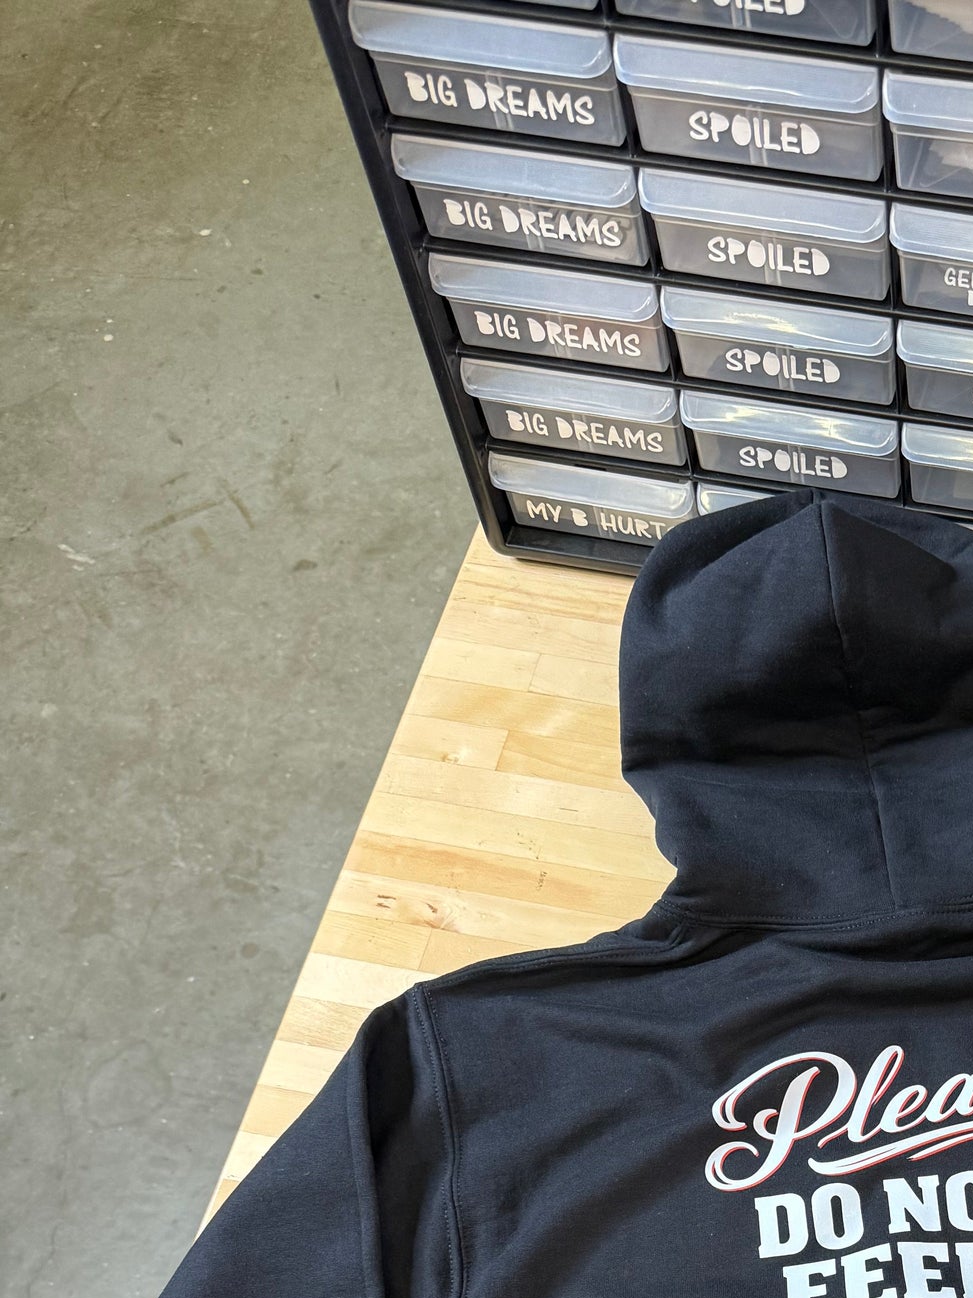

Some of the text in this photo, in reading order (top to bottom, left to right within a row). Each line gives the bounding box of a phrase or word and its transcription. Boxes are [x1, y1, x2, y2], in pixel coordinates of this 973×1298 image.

[404, 71, 595, 125] BIG DREAMS
[689, 110, 820, 155] SPOILED
[443, 198, 621, 247] BIG DREAMS
[707, 235, 830, 277] SPOILED
[474, 311, 641, 358] BIG DREAMS
[724, 347, 841, 384] SPOILED
[506, 409, 664, 453] BIG DREAMS
[739, 446, 848, 480] SPOILED
[526, 500, 675, 541] MY B HURT
[754, 1182, 863, 1259] DO
